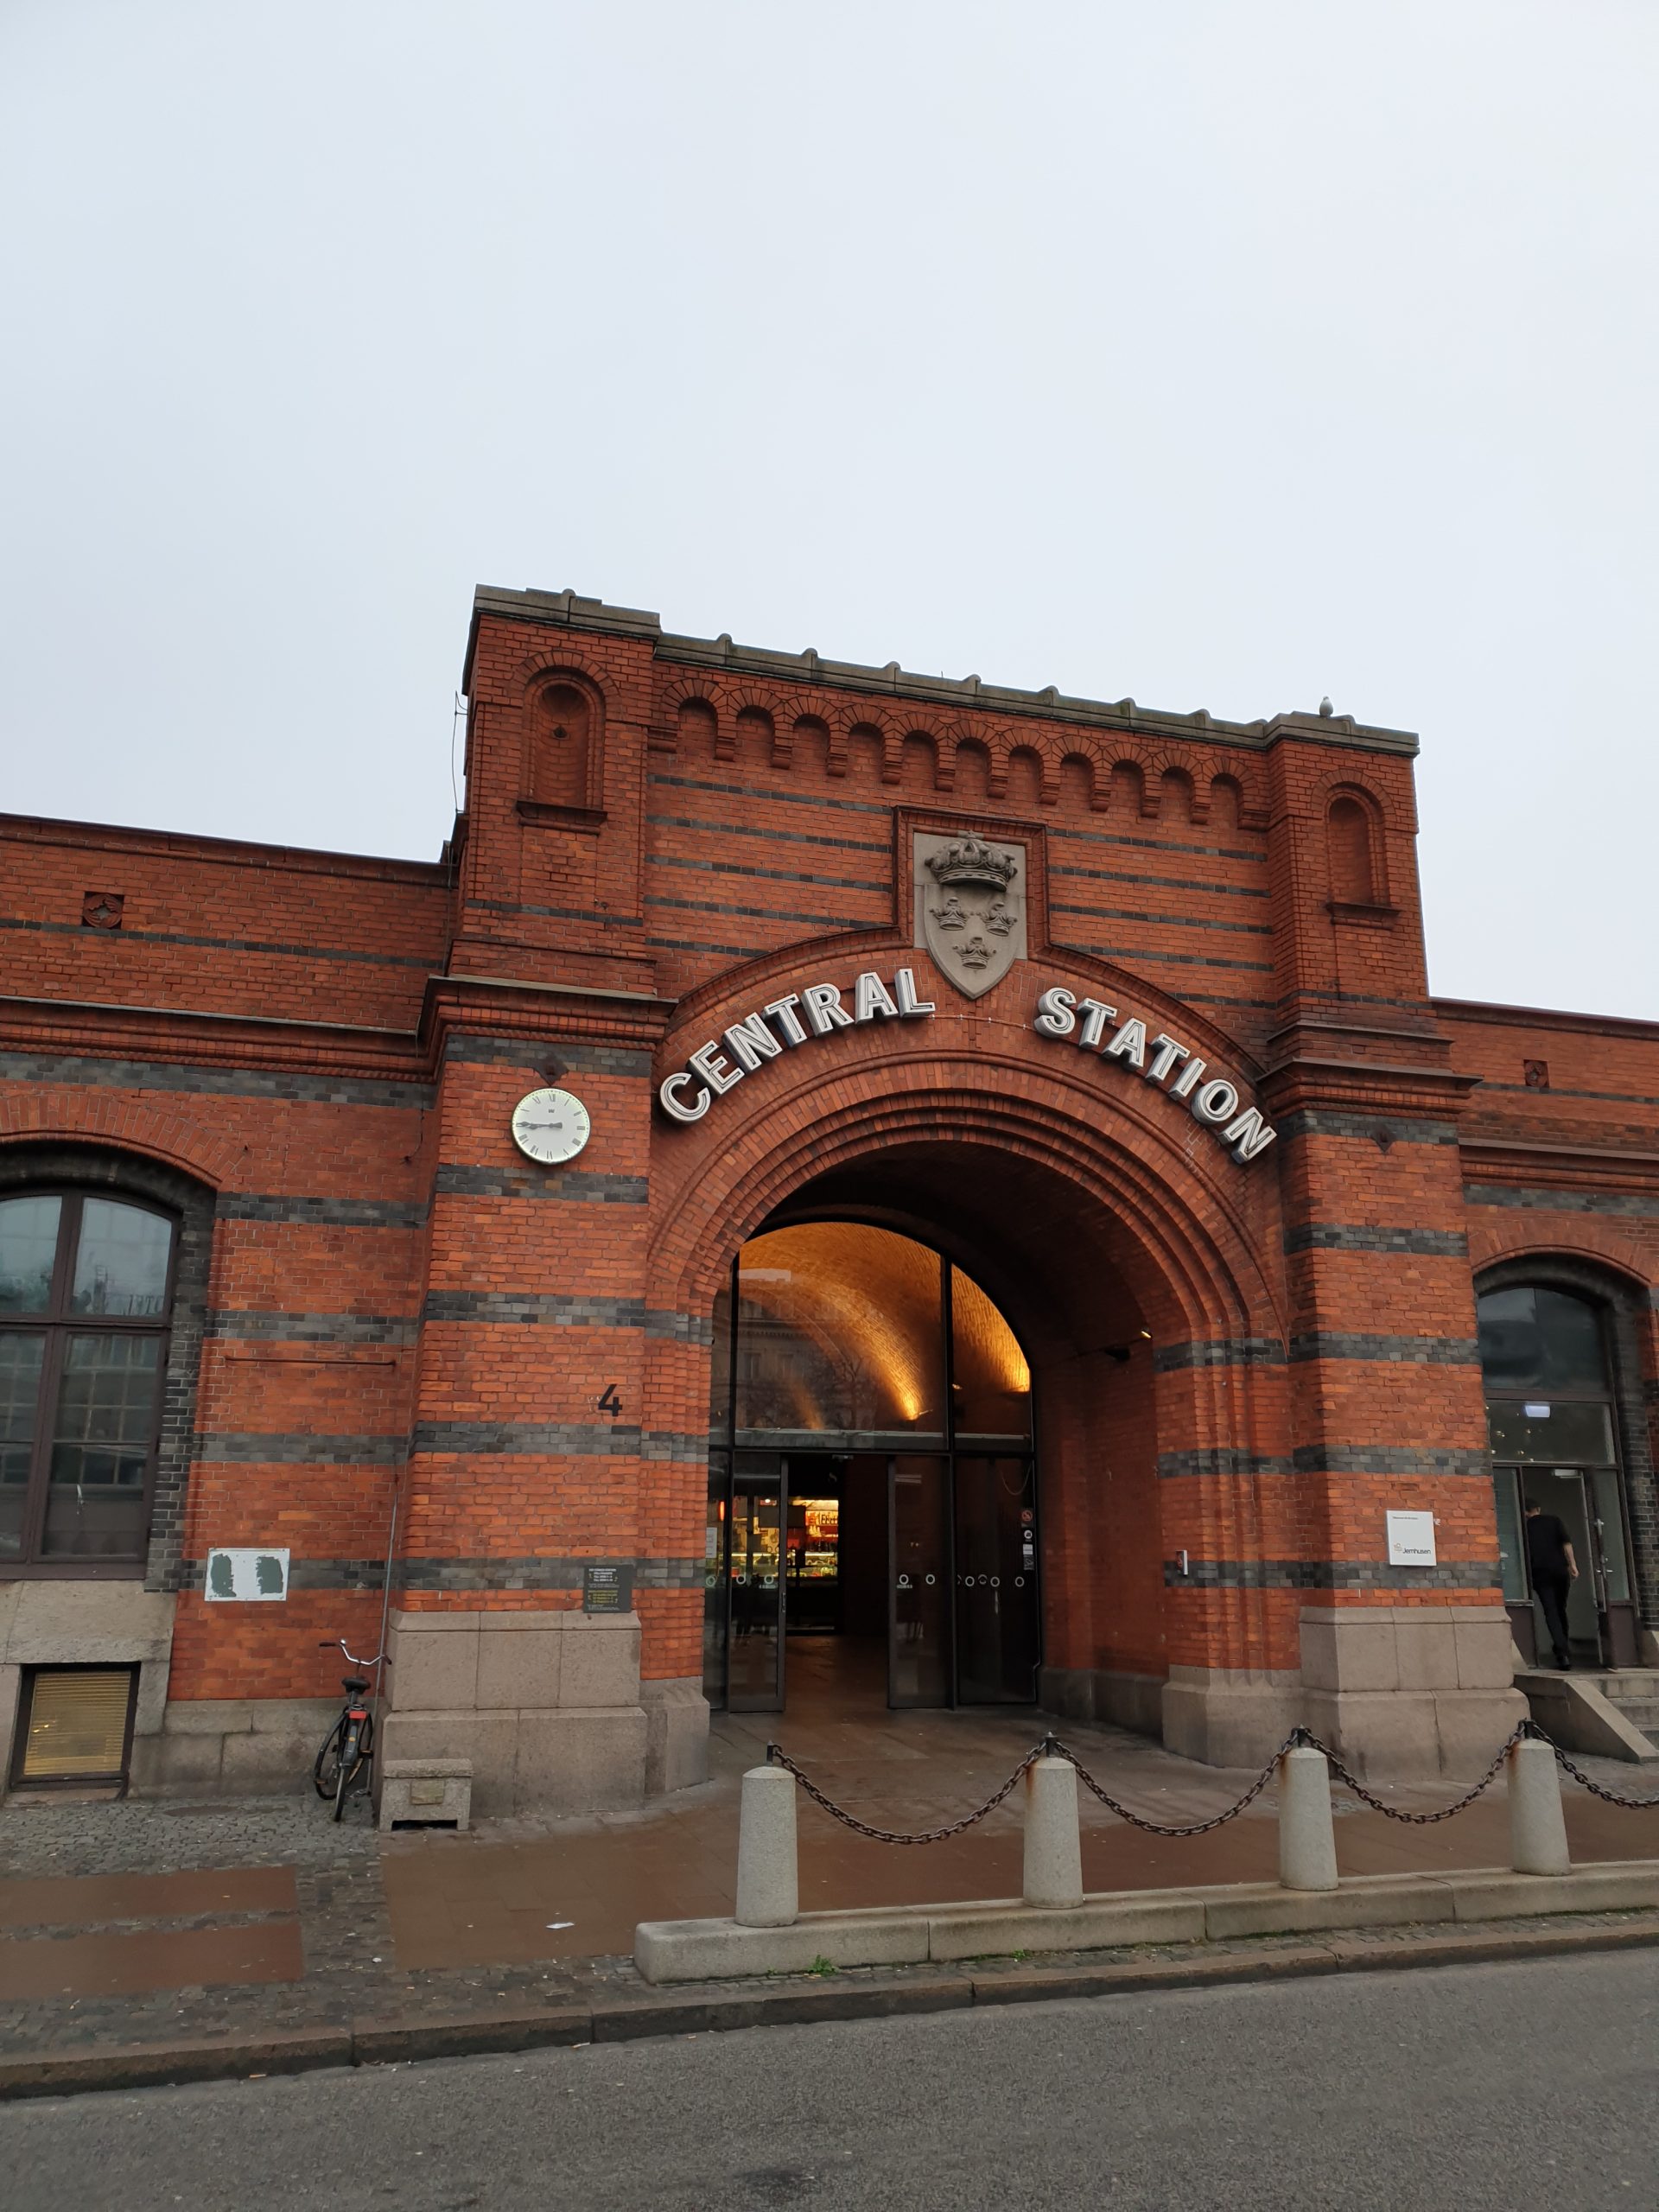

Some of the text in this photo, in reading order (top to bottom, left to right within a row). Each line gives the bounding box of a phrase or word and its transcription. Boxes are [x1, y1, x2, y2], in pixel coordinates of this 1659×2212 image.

[659, 968, 1278, 1164] CENTRAL STATION
[598, 1383, 623, 1417] 4
